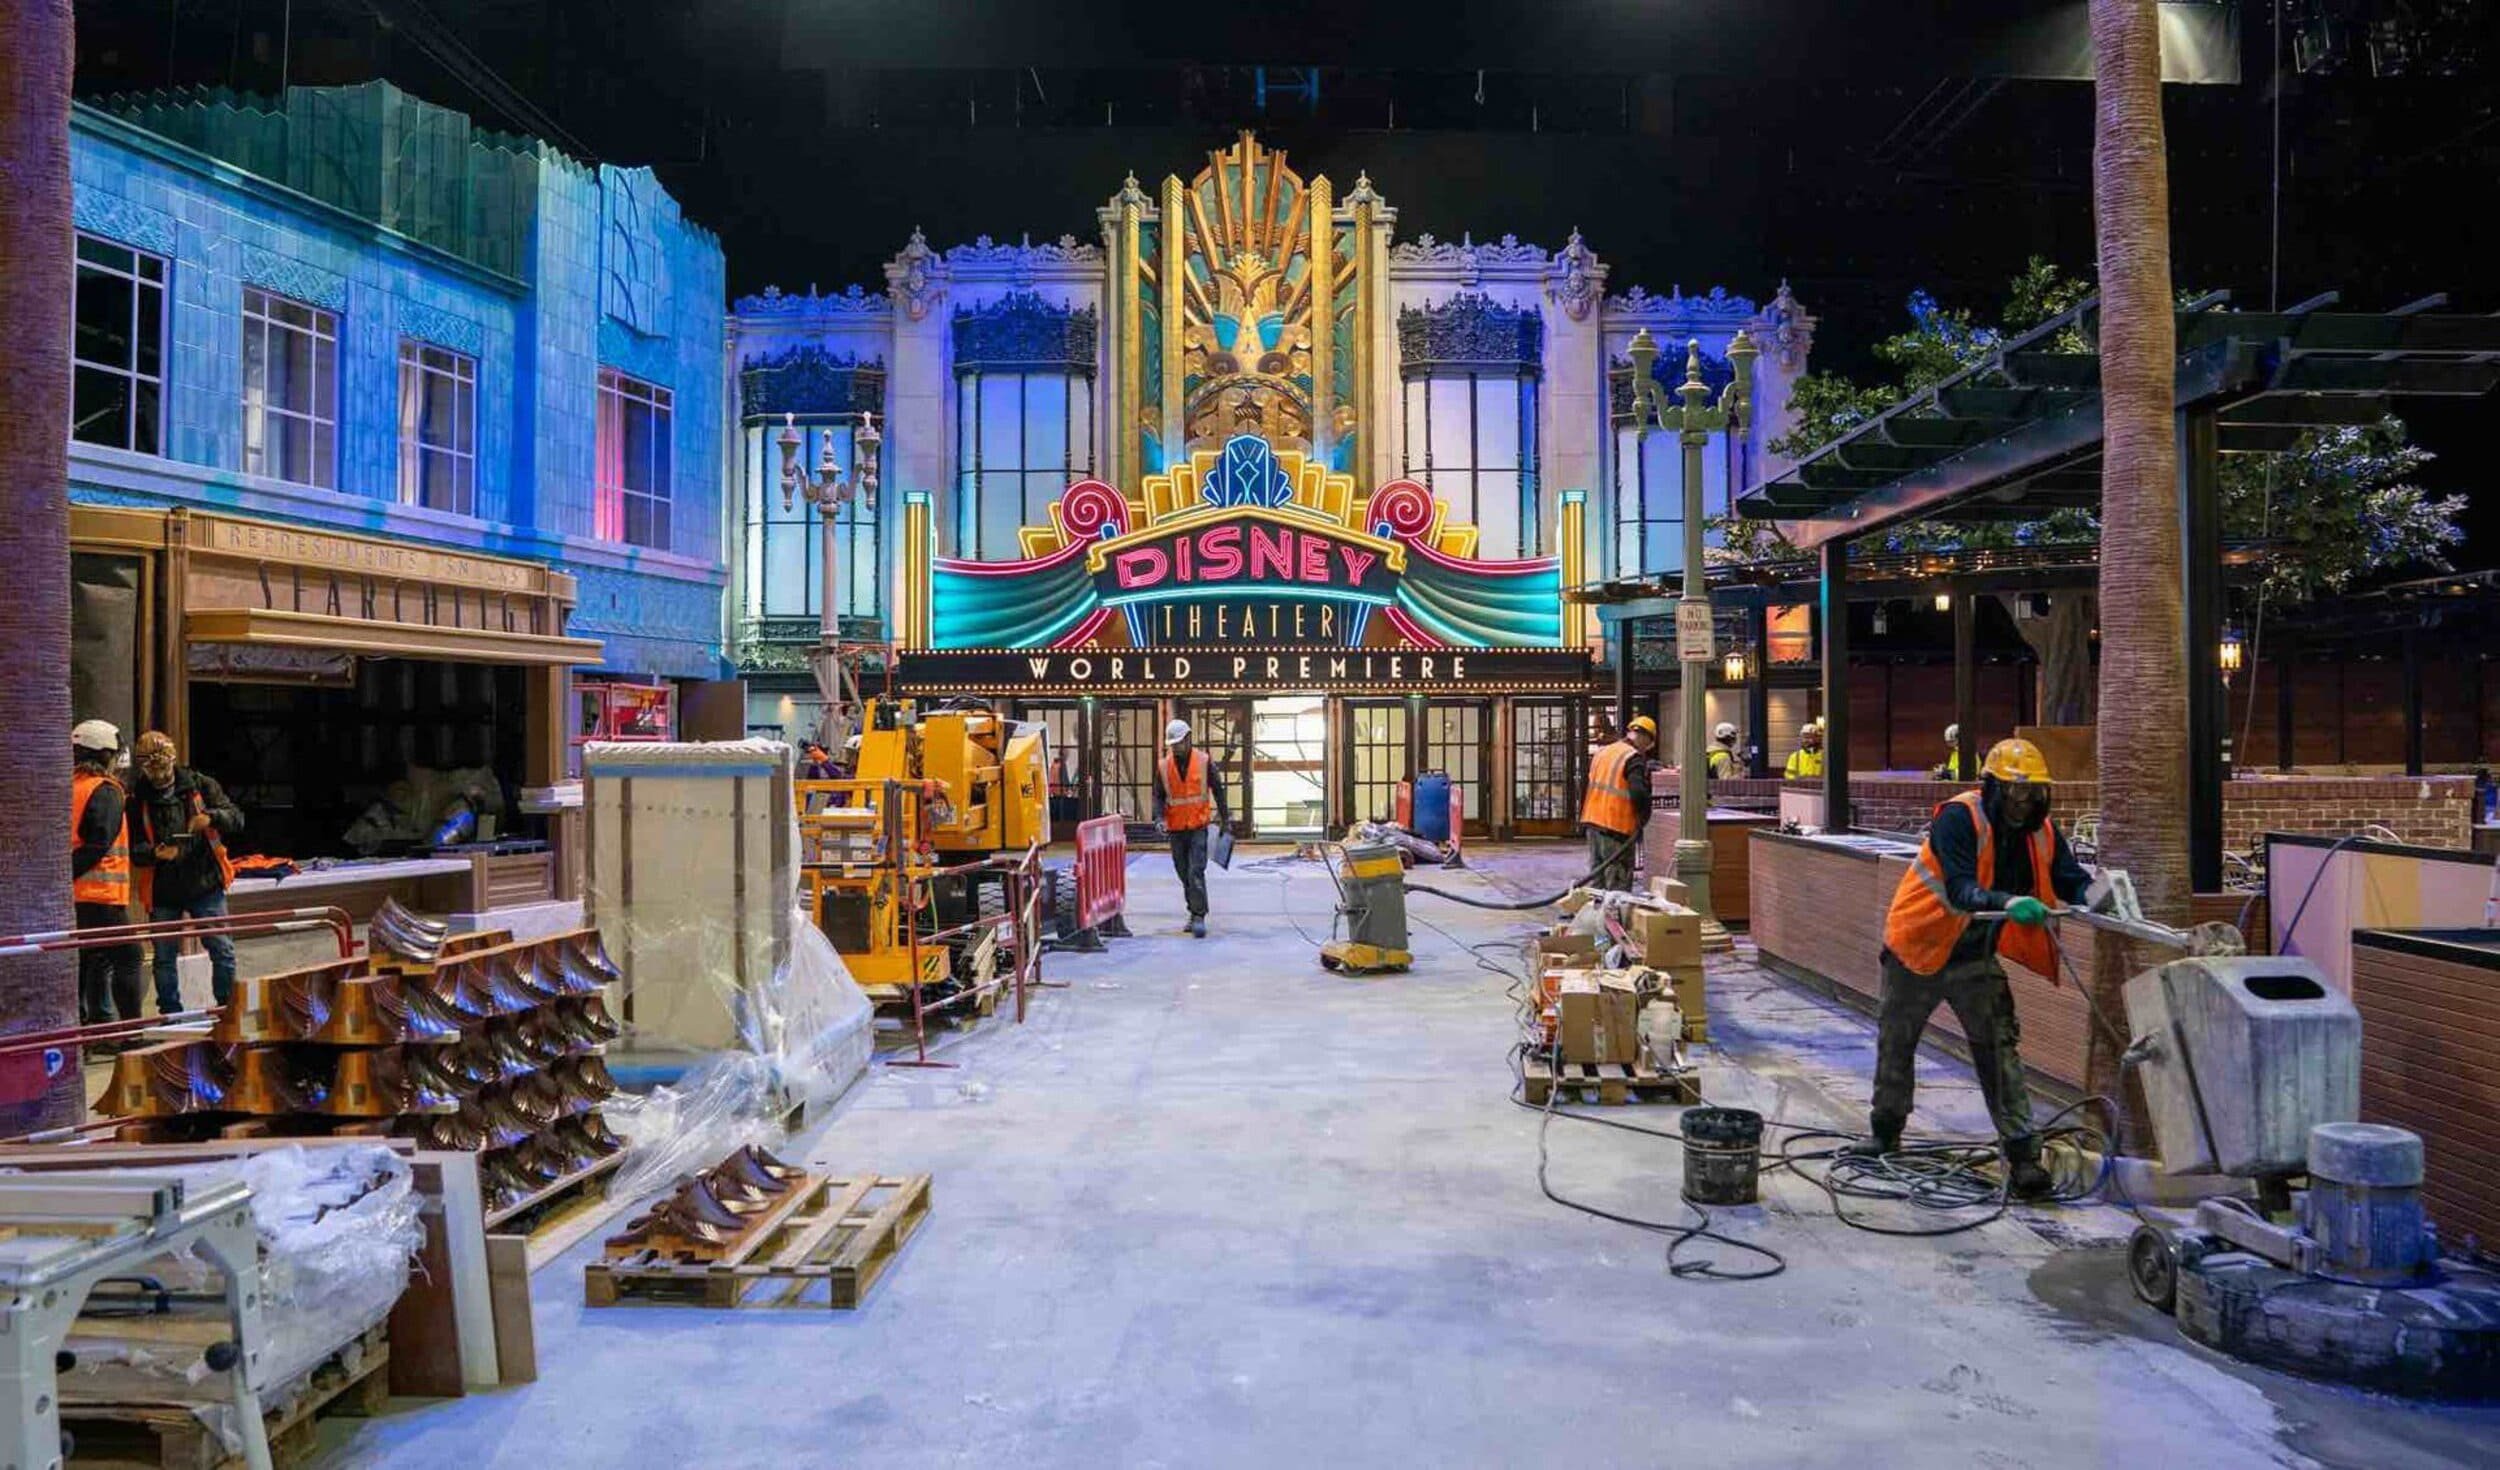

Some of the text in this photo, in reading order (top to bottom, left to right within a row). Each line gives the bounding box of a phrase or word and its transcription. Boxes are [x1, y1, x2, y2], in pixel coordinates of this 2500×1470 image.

[1115, 526, 1375, 588] DISNEY
[1163, 604, 1334, 639] THEATER
[1687, 607, 1702, 620] NO
[1028, 656, 1465, 680] WORLD PREMIERE
